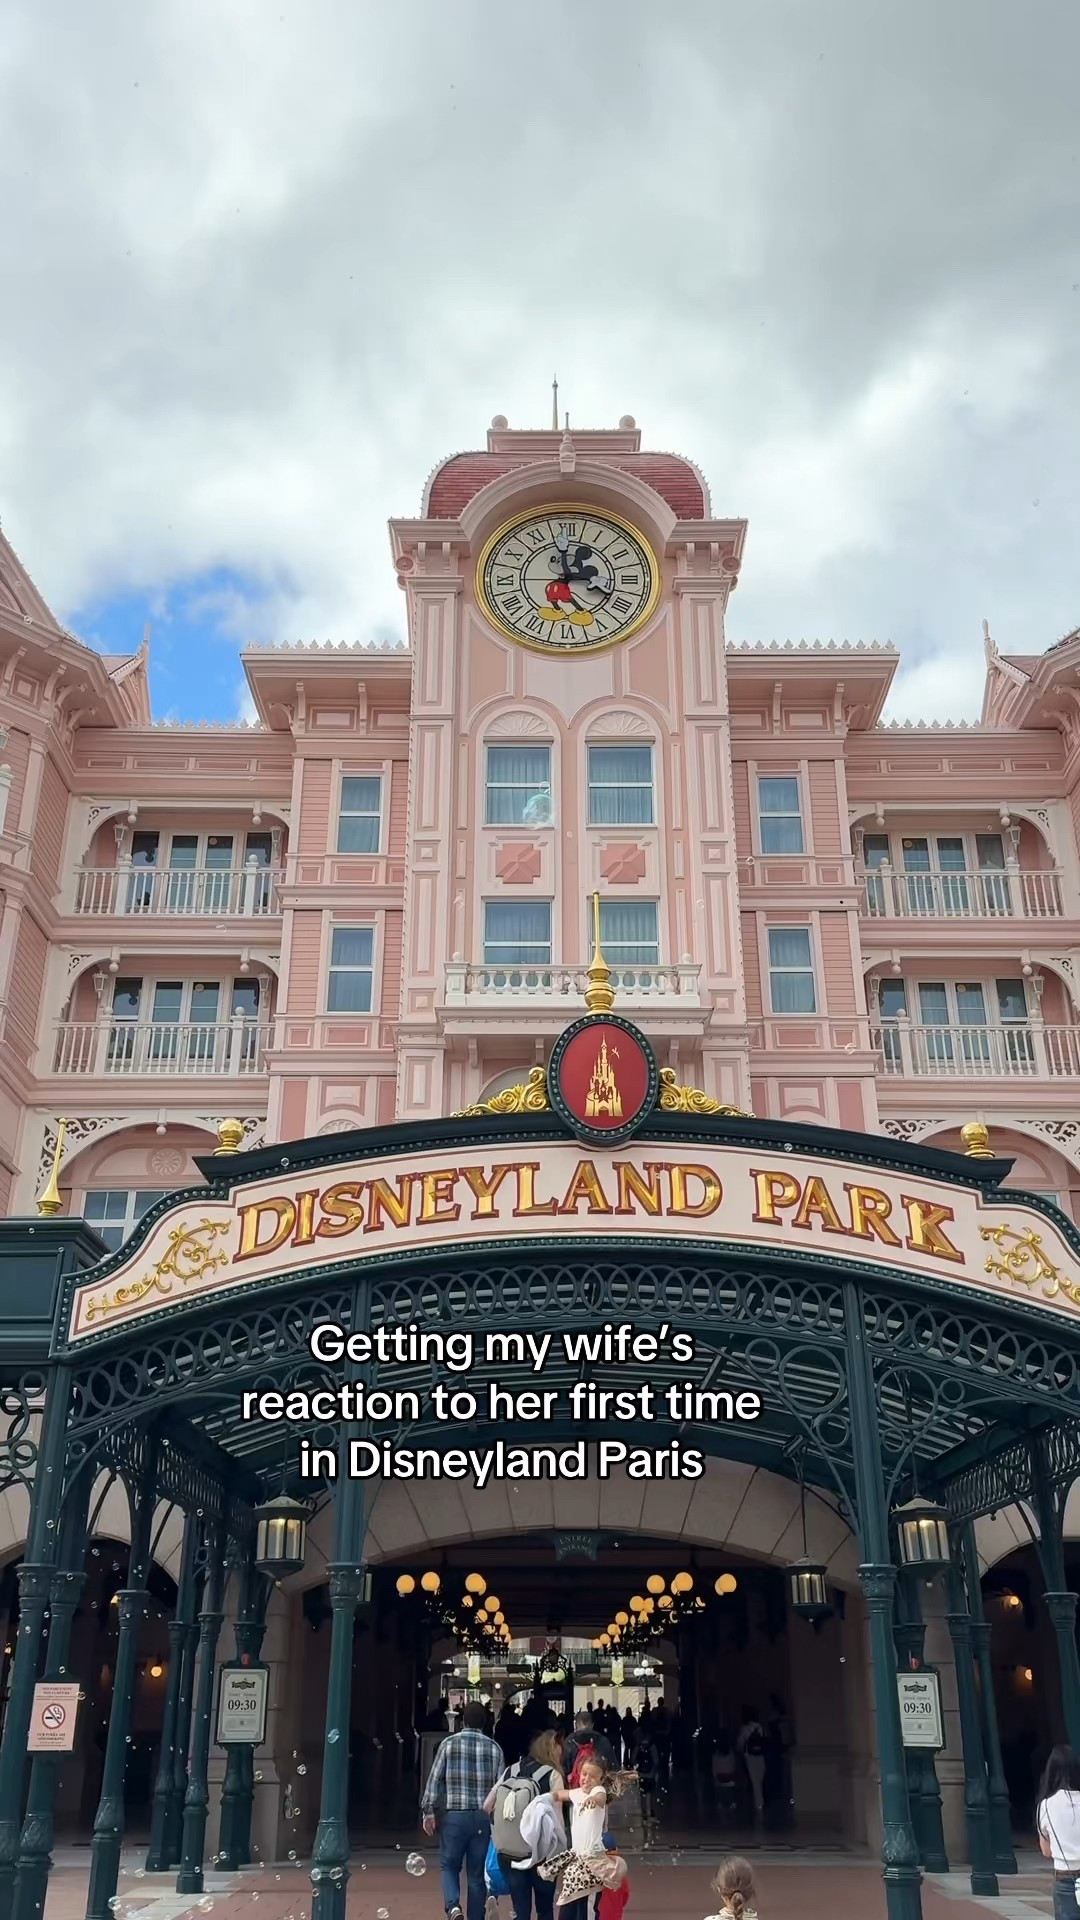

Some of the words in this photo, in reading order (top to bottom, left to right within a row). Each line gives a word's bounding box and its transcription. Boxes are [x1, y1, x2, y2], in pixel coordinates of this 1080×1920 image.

[504, 548, 524, 561] X
[612, 548, 630, 560] II
[621, 574, 638, 585] III
[233, 1160, 723, 1264] DISNEYLAND
[750, 1168, 965, 1265] PARK
[228, 1700, 257, 1711] 09:30
[903, 1702, 932, 1714] 09:30
